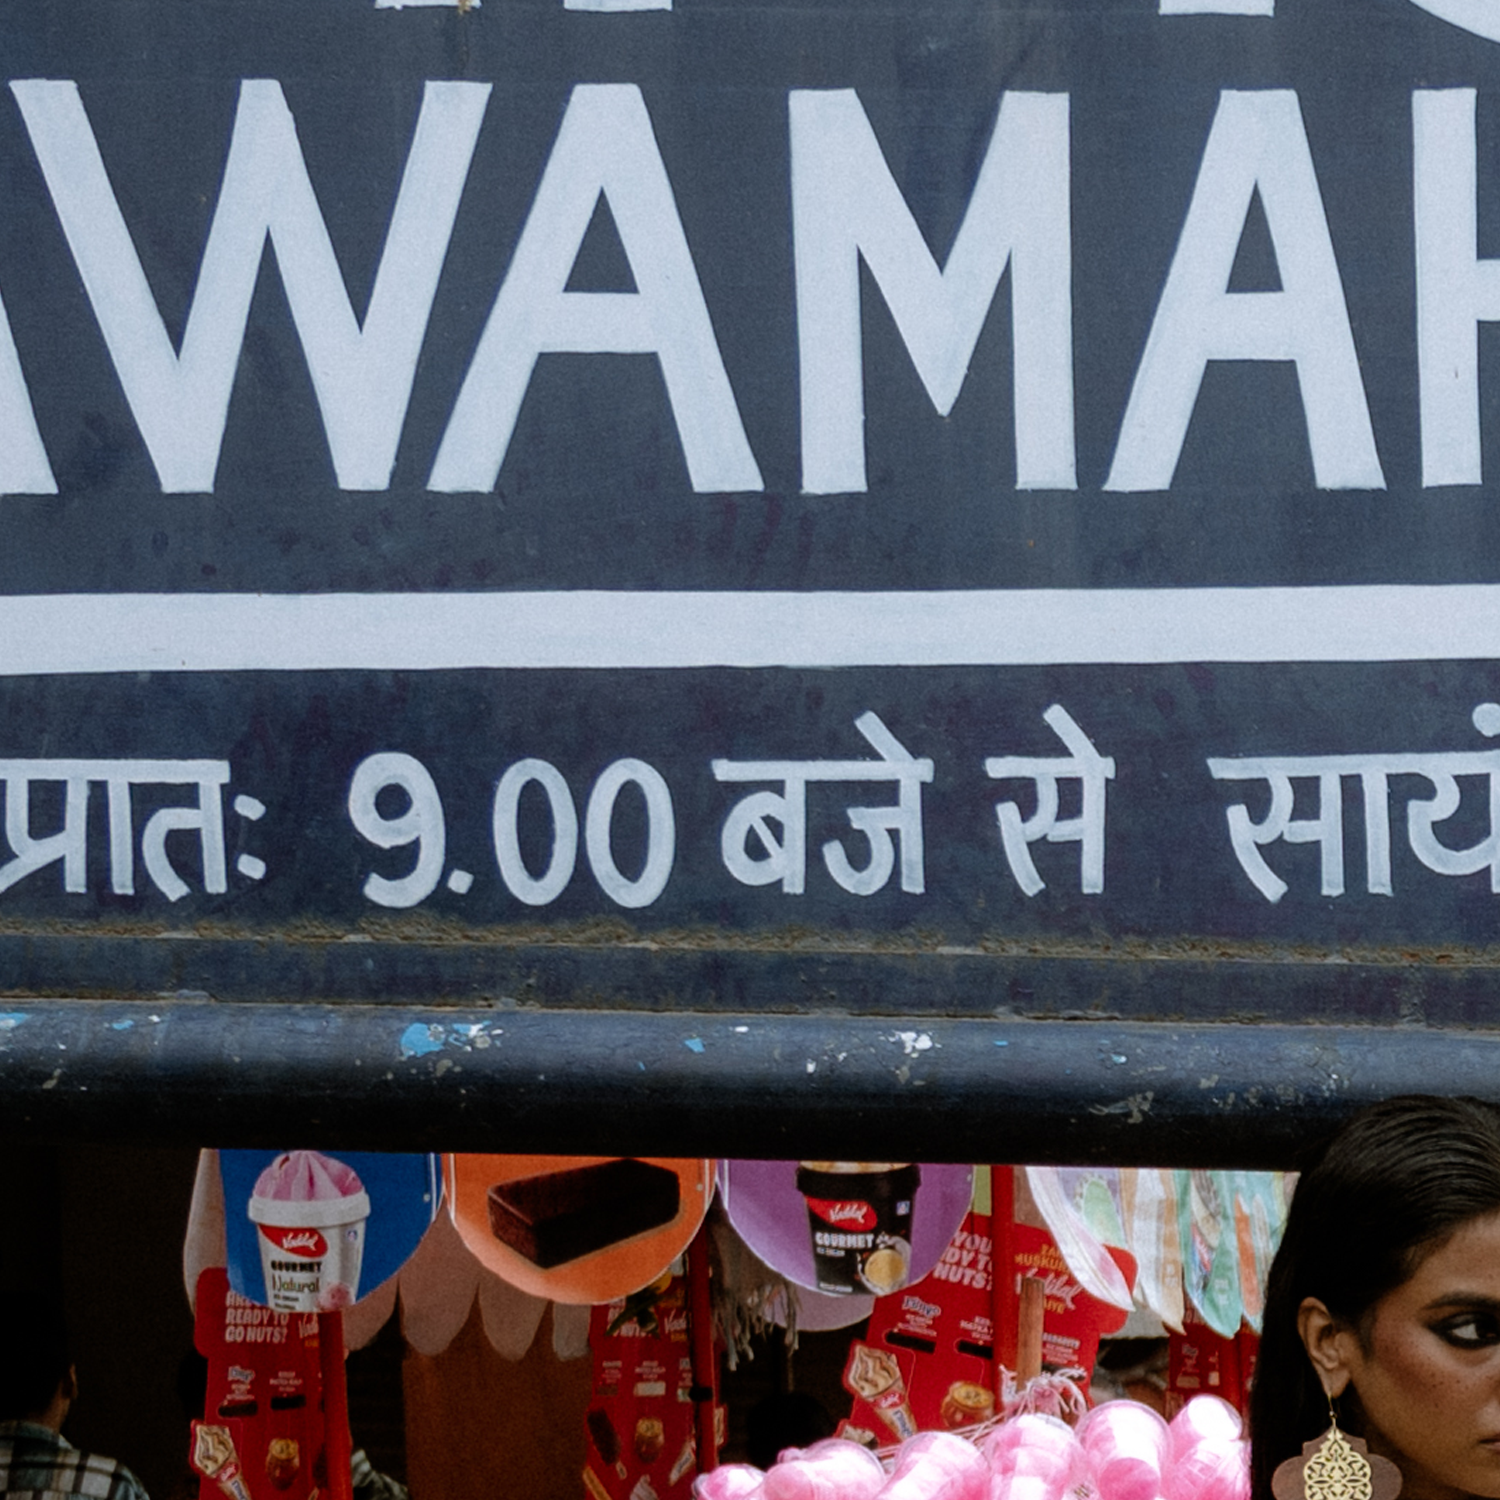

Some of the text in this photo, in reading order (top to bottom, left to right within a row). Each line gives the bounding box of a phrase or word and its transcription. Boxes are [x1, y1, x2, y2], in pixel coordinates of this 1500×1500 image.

[348, 752, 675, 909] 9.00
[711, 711, 934, 896] बजे
[985, 703, 1115, 897] से
[225, 1326, 244, 1344] GO
